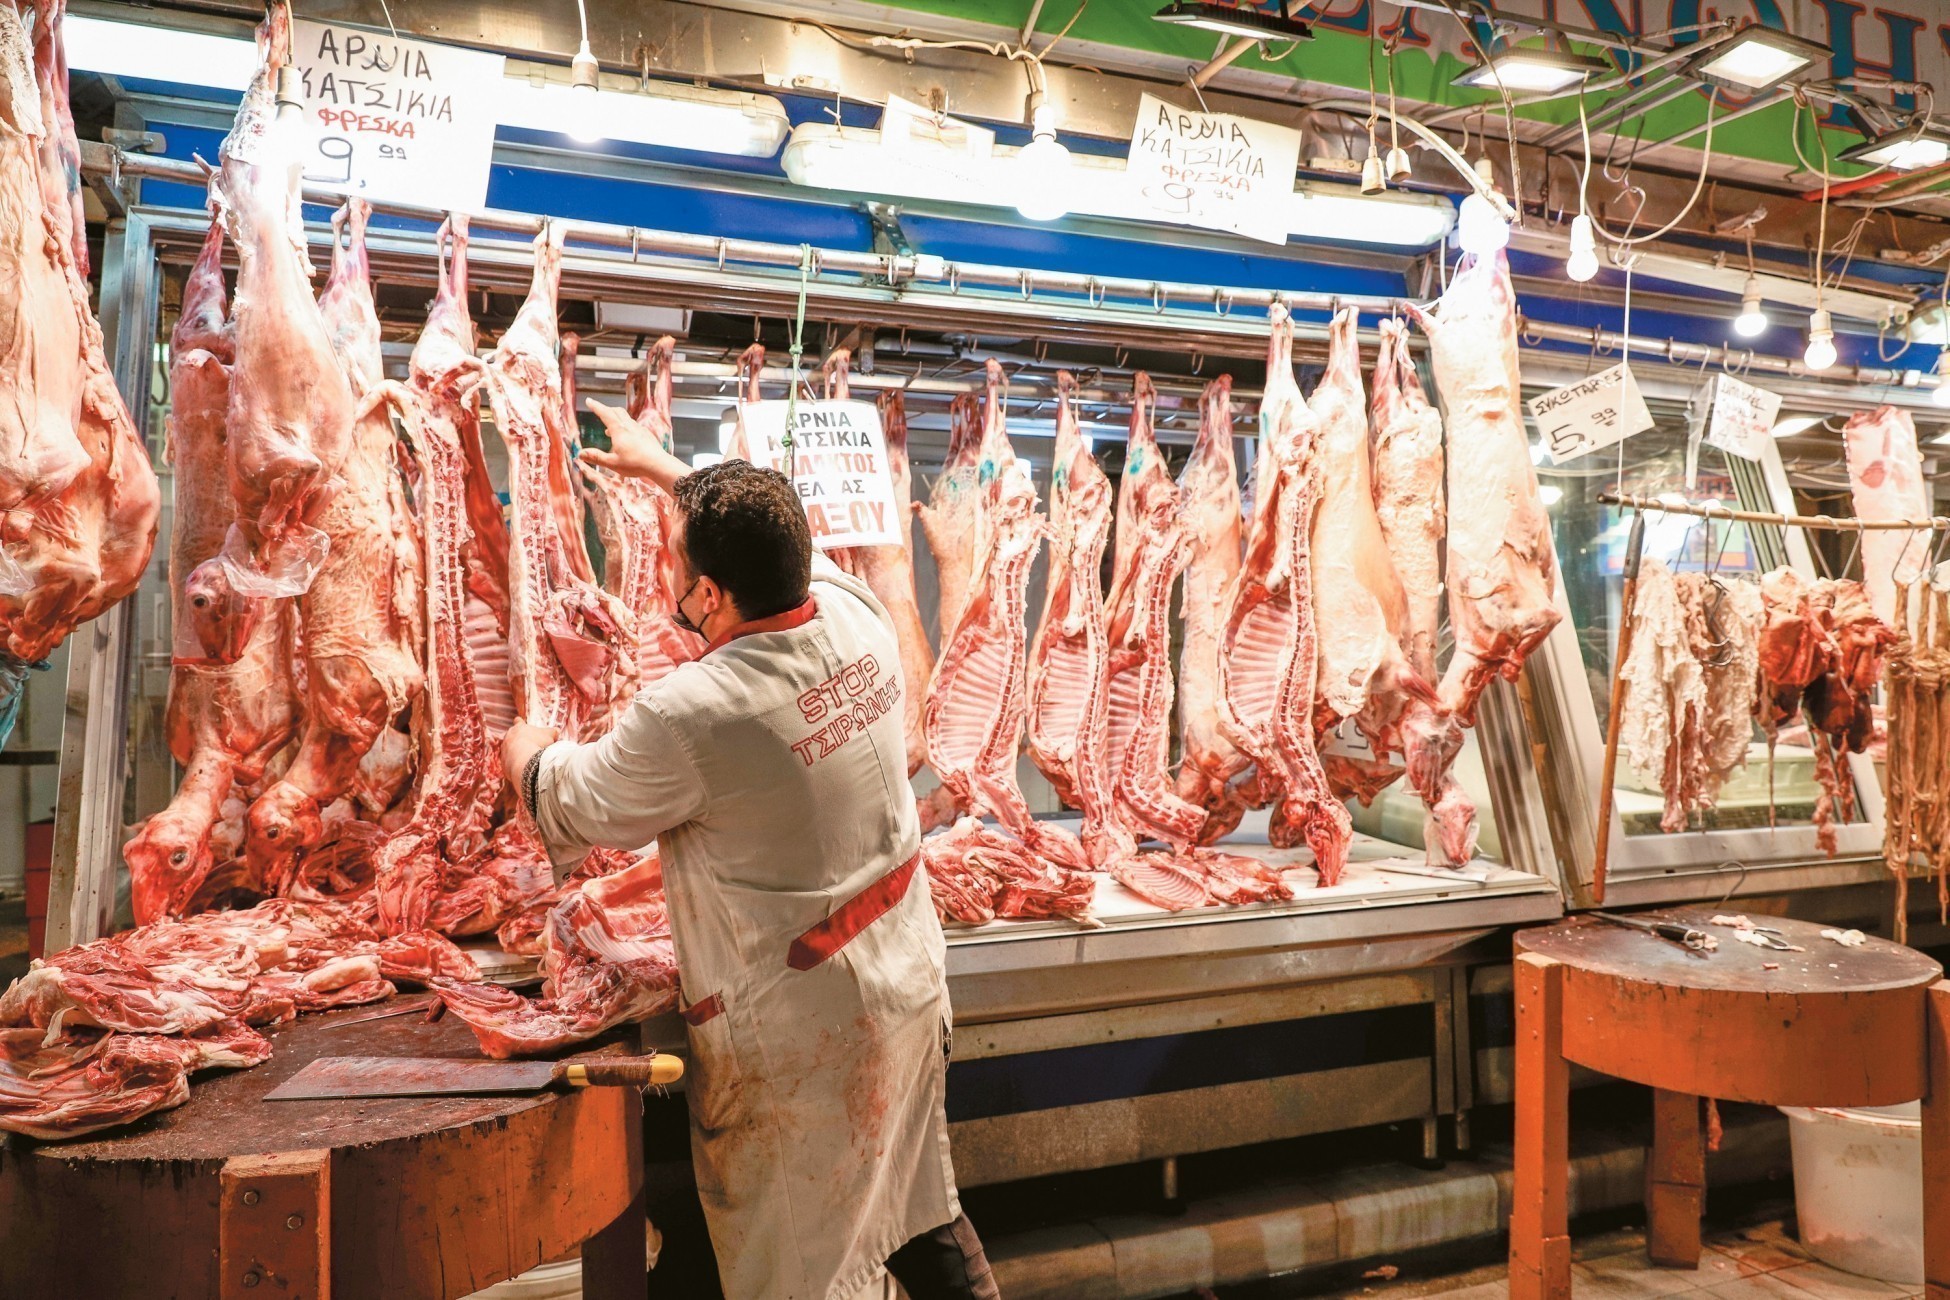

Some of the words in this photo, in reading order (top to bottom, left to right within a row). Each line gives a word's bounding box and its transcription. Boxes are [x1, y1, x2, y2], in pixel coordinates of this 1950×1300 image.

[318, 28, 432, 81] ΑΡΝΙΑ
[302, 67, 452, 123] ΚΑΤΣΙΚΙΑ
[318, 108, 415, 139] ΦΡΕΣΚΑ
[1158, 104, 1251, 148] ΑΡΝΙΑ
[1141, 128, 1264, 179] ΚΑΤΣΙΚΙΑ
[1162, 164, 1250, 192] ΦΡΕΣΚΑ
[771, 452, 877, 477] ΓΛΚΤΟΣ
[806, 500, 885, 538] ΑΞΟΥ
[797, 654, 880, 724] STOP
[791, 675, 901, 767] ΤΣΙΡΩΝΗΣ
